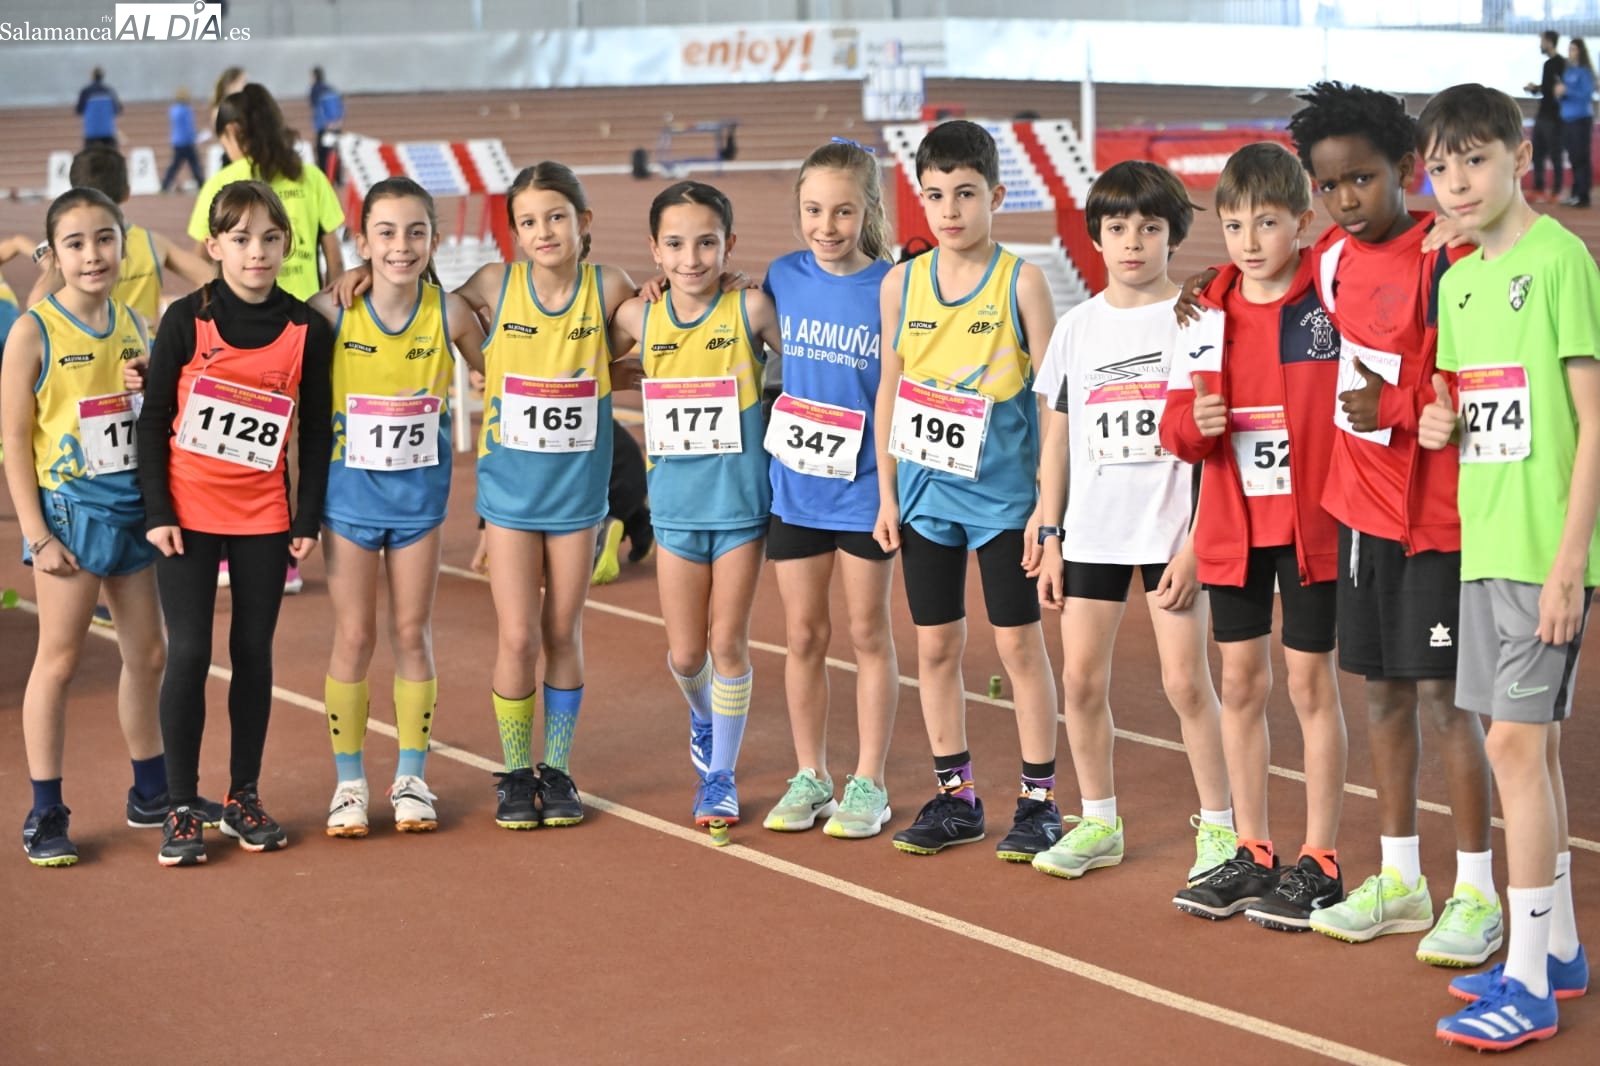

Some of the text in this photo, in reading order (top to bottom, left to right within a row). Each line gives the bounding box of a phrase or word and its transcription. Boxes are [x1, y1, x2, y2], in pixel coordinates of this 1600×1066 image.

[683, 30, 814, 73] enjoy!
[795, 318, 880, 360] ARMUÑA
[783, 343, 868, 370] CLUB DEPORTIVO
[198, 406, 280, 447] 1128
[523, 405, 582, 431] 165
[665, 407, 723, 432] 177
[911, 413, 966, 449] 196
[1096, 409, 1157, 439] 118
[369, 422, 425, 449] 175
[786, 425, 846, 458] 347
